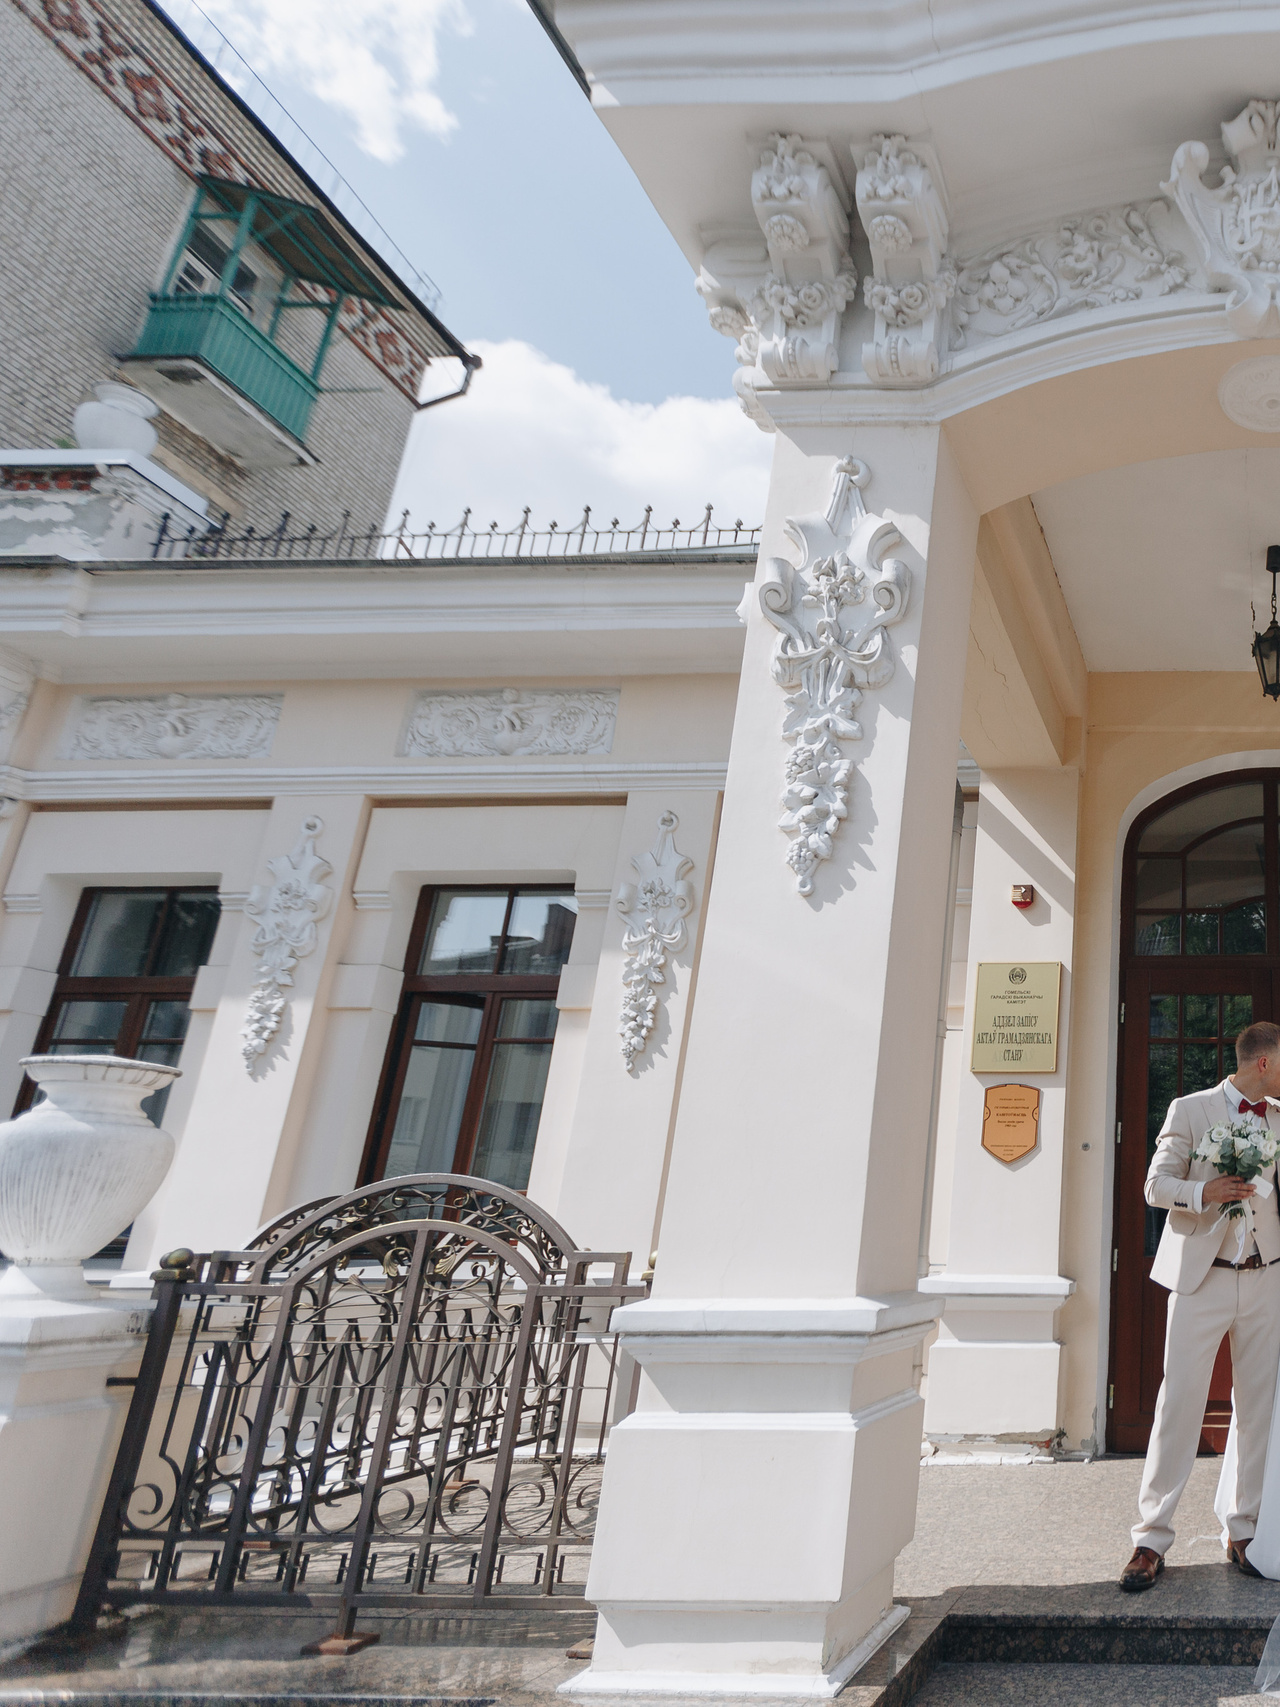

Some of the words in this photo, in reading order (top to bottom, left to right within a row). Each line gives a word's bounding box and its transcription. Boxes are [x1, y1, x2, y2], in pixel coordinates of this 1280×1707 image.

[992, 1015, 1016, 1029] АДДЗЕЛ
[1017, 1014, 1038, 1027] ЗАПІСУ
[976, 1029, 997, 1044] АКТАЎ
[997, 1032, 1052, 1045] ГРАМАДЗЯНСКАГА
[1003, 1049, 1023, 1061] СТАНУ
